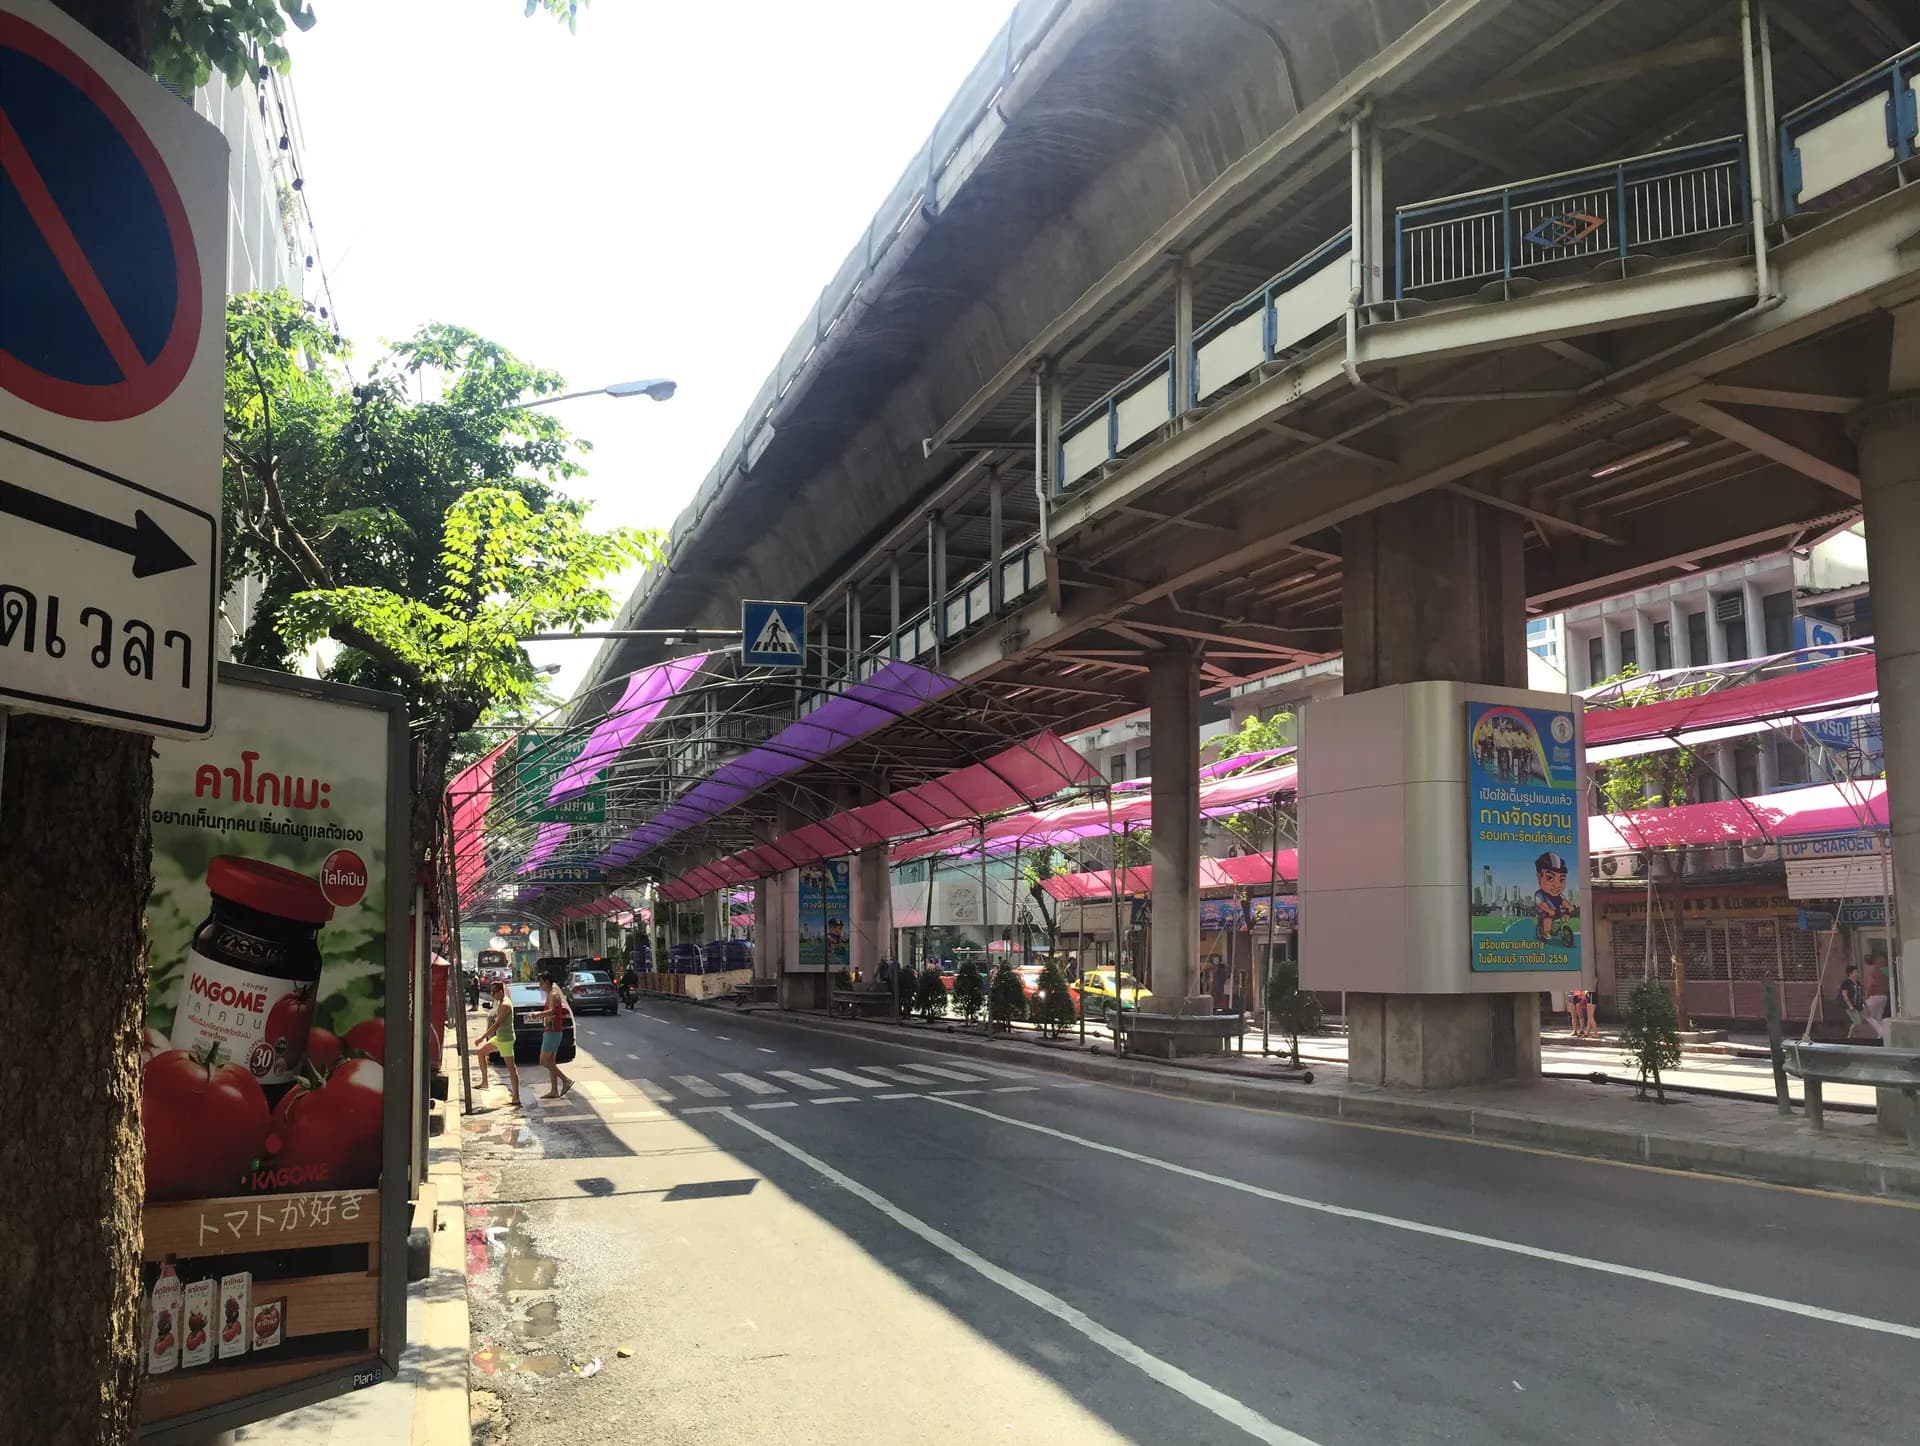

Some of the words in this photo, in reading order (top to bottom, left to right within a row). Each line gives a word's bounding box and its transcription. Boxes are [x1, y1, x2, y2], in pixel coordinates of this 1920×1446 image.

[195, 751, 331, 810] คาโกเมะ
[1480, 788, 1572, 806] เปิดใช้เต็มรูปแบบแล้ว
[151, 808, 256, 835] อยากเห็นทุกคน
[259, 813, 364, 842] เริ่มต้นดูแลตัวเอง
[1480, 806, 1572, 829] ทางจักรยาน
[1480, 831, 1572, 845] รอบเกาะรัตนโกสินทร์
[1785, 843, 1807, 856] TOP
[1813, 837, 1873, 854] CHAROEN
[323, 868, 365, 887] ไลโคปีน
[190, 972, 267, 1014] KAGOME
[252, 1048, 272, 1068] 30
[252, 1163, 328, 1190] KAGOME
[199, 1194, 362, 1247] トマトが好き
